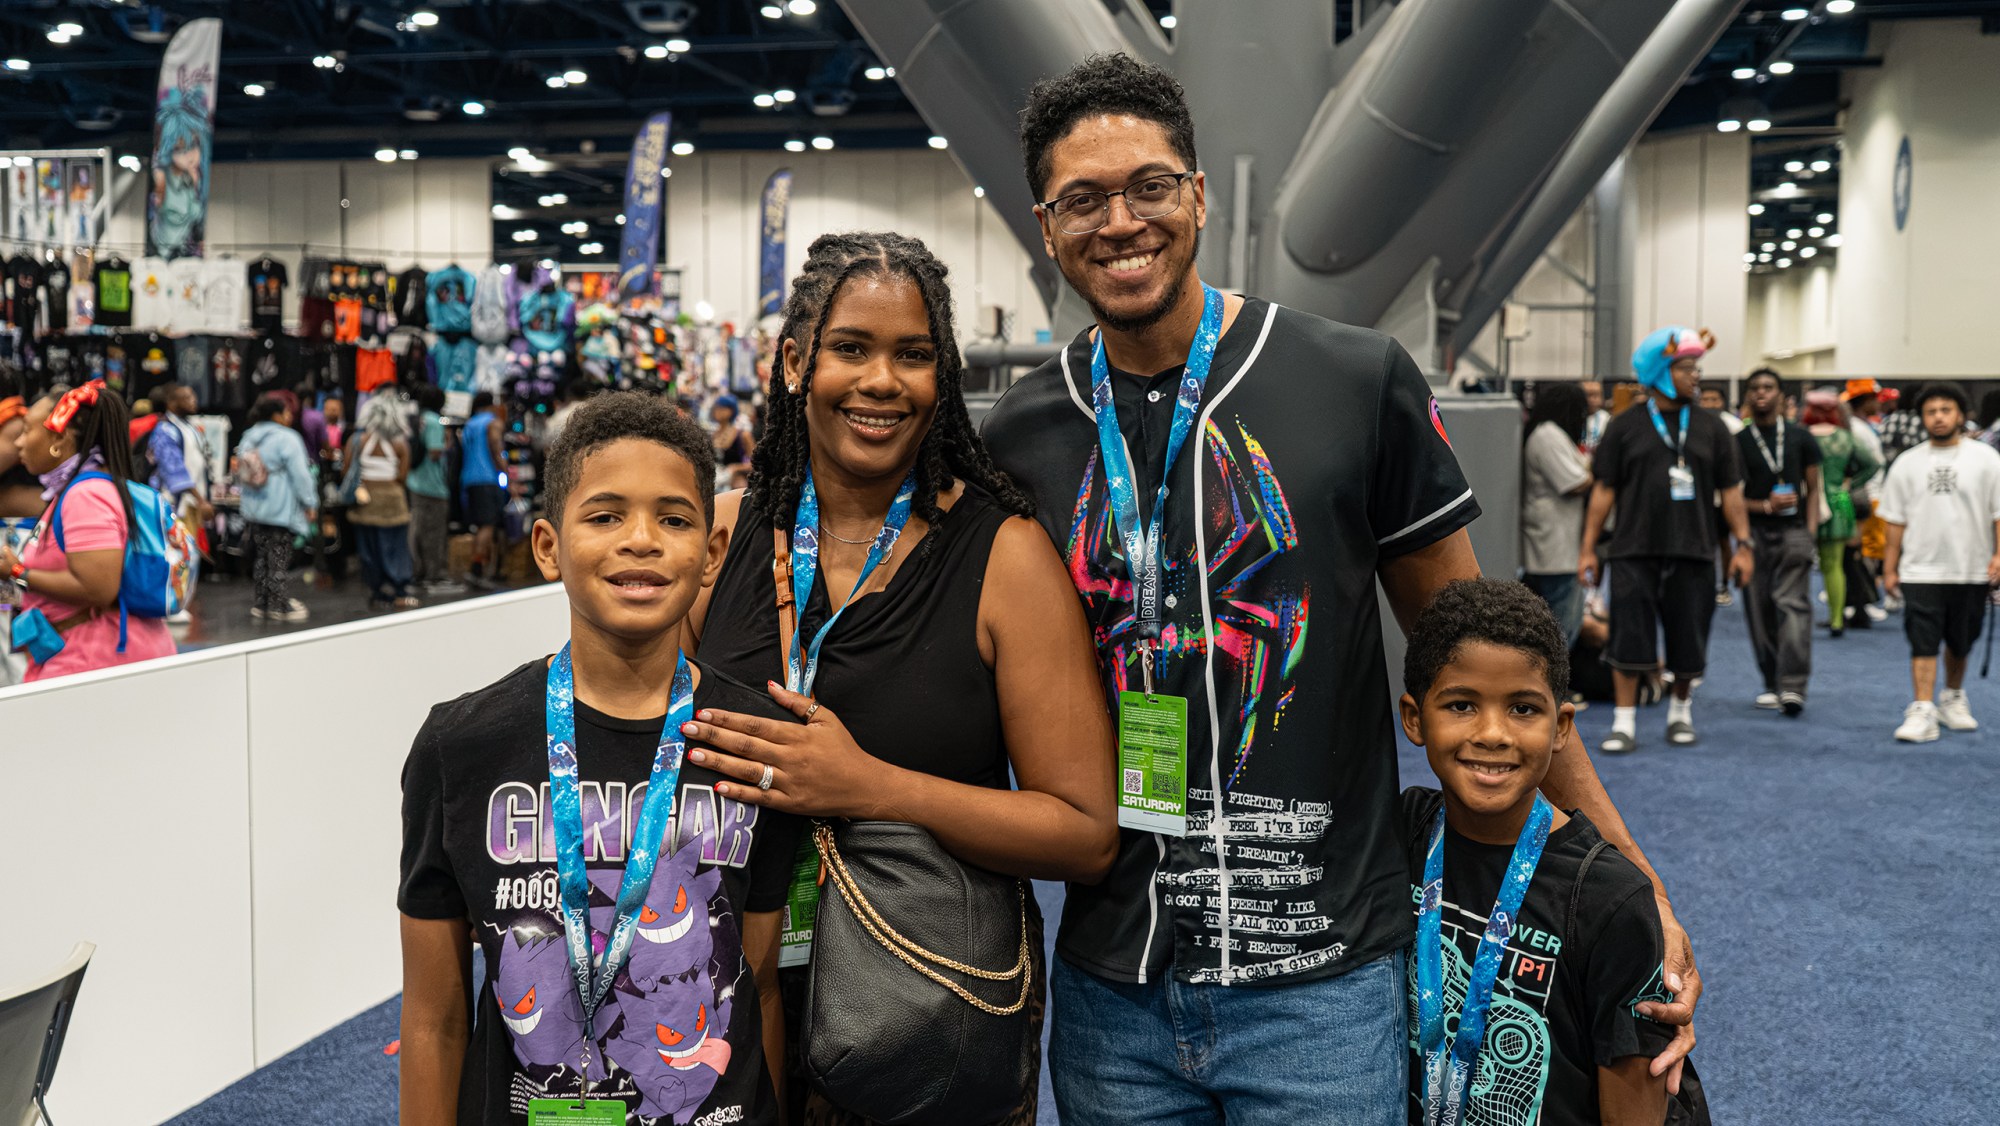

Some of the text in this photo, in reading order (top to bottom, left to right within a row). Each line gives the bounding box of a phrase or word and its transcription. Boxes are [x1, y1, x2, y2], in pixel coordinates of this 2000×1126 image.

[1141, 566, 1157, 618] DREAM
[1122, 795, 1181, 813] SATURDAY
[1188, 787, 1223, 801] STIL
[1228, 791, 1284, 811] FIGHTING
[1187, 816, 1323, 833] DON' FEEL I'VE LOST
[1200, 841, 1217, 854] AM
[1223, 844, 1231, 856] I
[1185, 874, 1221, 885] THER
[1232, 874, 1264, 886] MORE
[1269, 874, 1301, 886] LIKE
[1306, 867, 1323, 883] US?
[494, 878, 562, 910] #009
[1175, 895, 1201, 907] GOT
[1206, 896, 1221, 908] ME
[1229, 899, 1278, 913] FEELIN'
[1286, 901, 1316, 914] LIKE
[1241, 917, 1262, 929] ALL
[1267, 919, 1289, 931] TOO
[1295, 918, 1325, 932] MUCH
[782, 930, 813, 943] ATURD
[1194, 935, 1202, 946] I
[1247, 940, 1303, 956] BEATEN,
[1204, 970, 1221, 981] BU
[1246, 963, 1283, 978] CAN'T
[1289, 954, 1321, 971] GIVE
[1326, 946, 1342, 960] UP
[1517, 957, 1546, 982] P1
